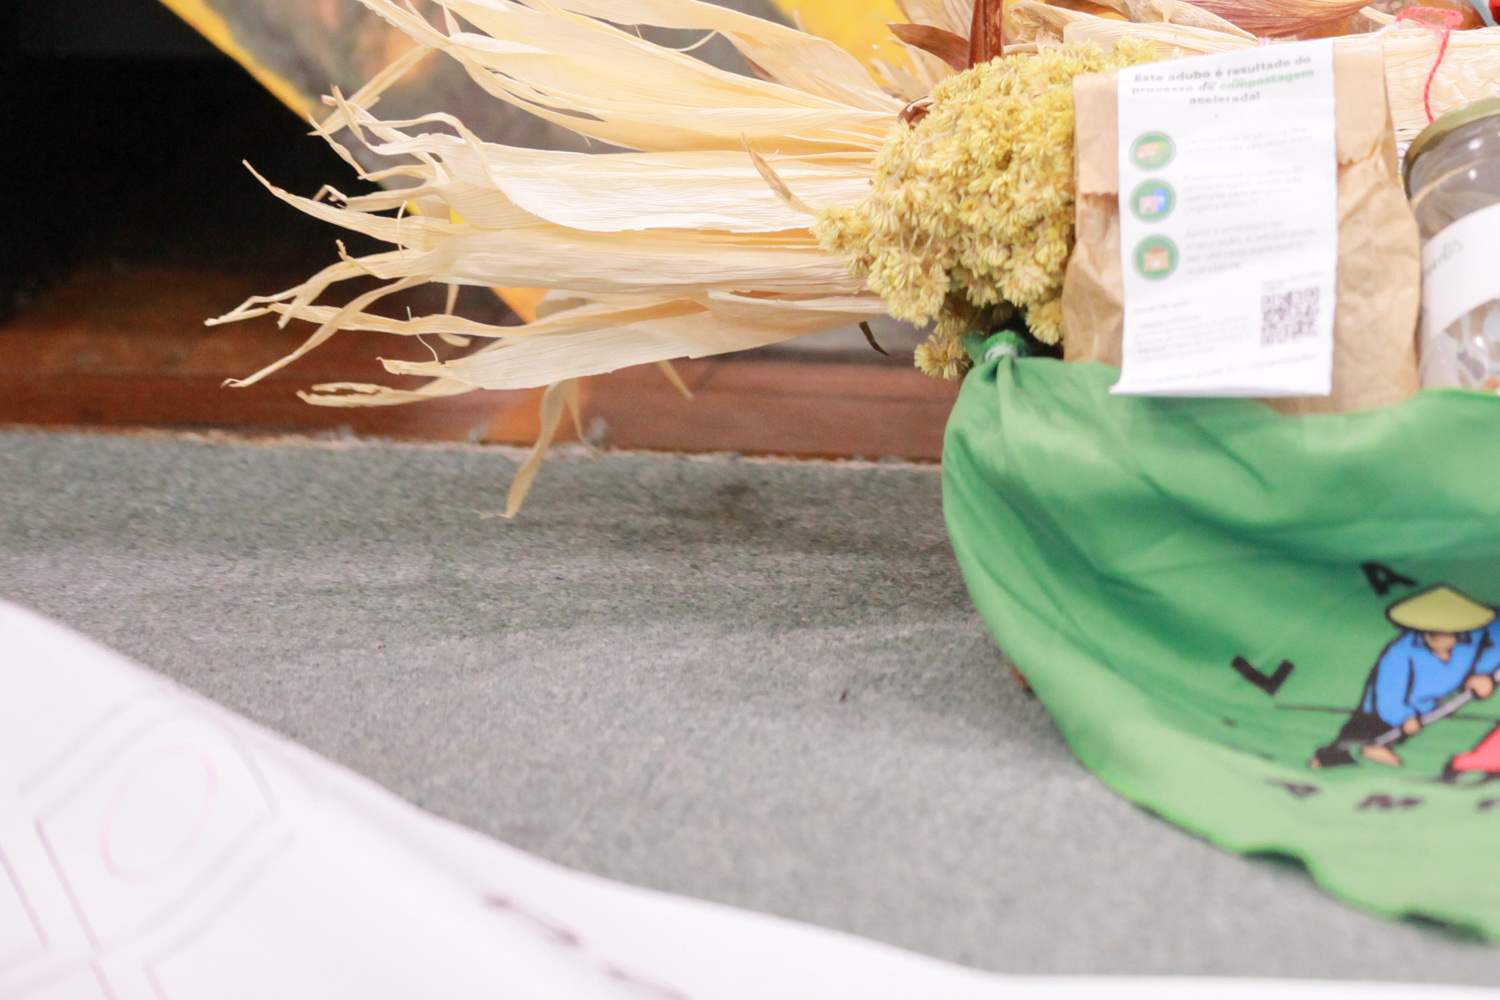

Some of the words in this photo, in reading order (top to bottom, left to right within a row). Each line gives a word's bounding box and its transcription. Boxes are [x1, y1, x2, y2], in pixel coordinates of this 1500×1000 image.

[1134, 74, 1163, 83] Este
[1168, 69, 1211, 81] adubo
[1227, 58, 1290, 77] resultado
[1294, 56, 1311, 66] do
[1219, 69, 1314, 91] compostagem
